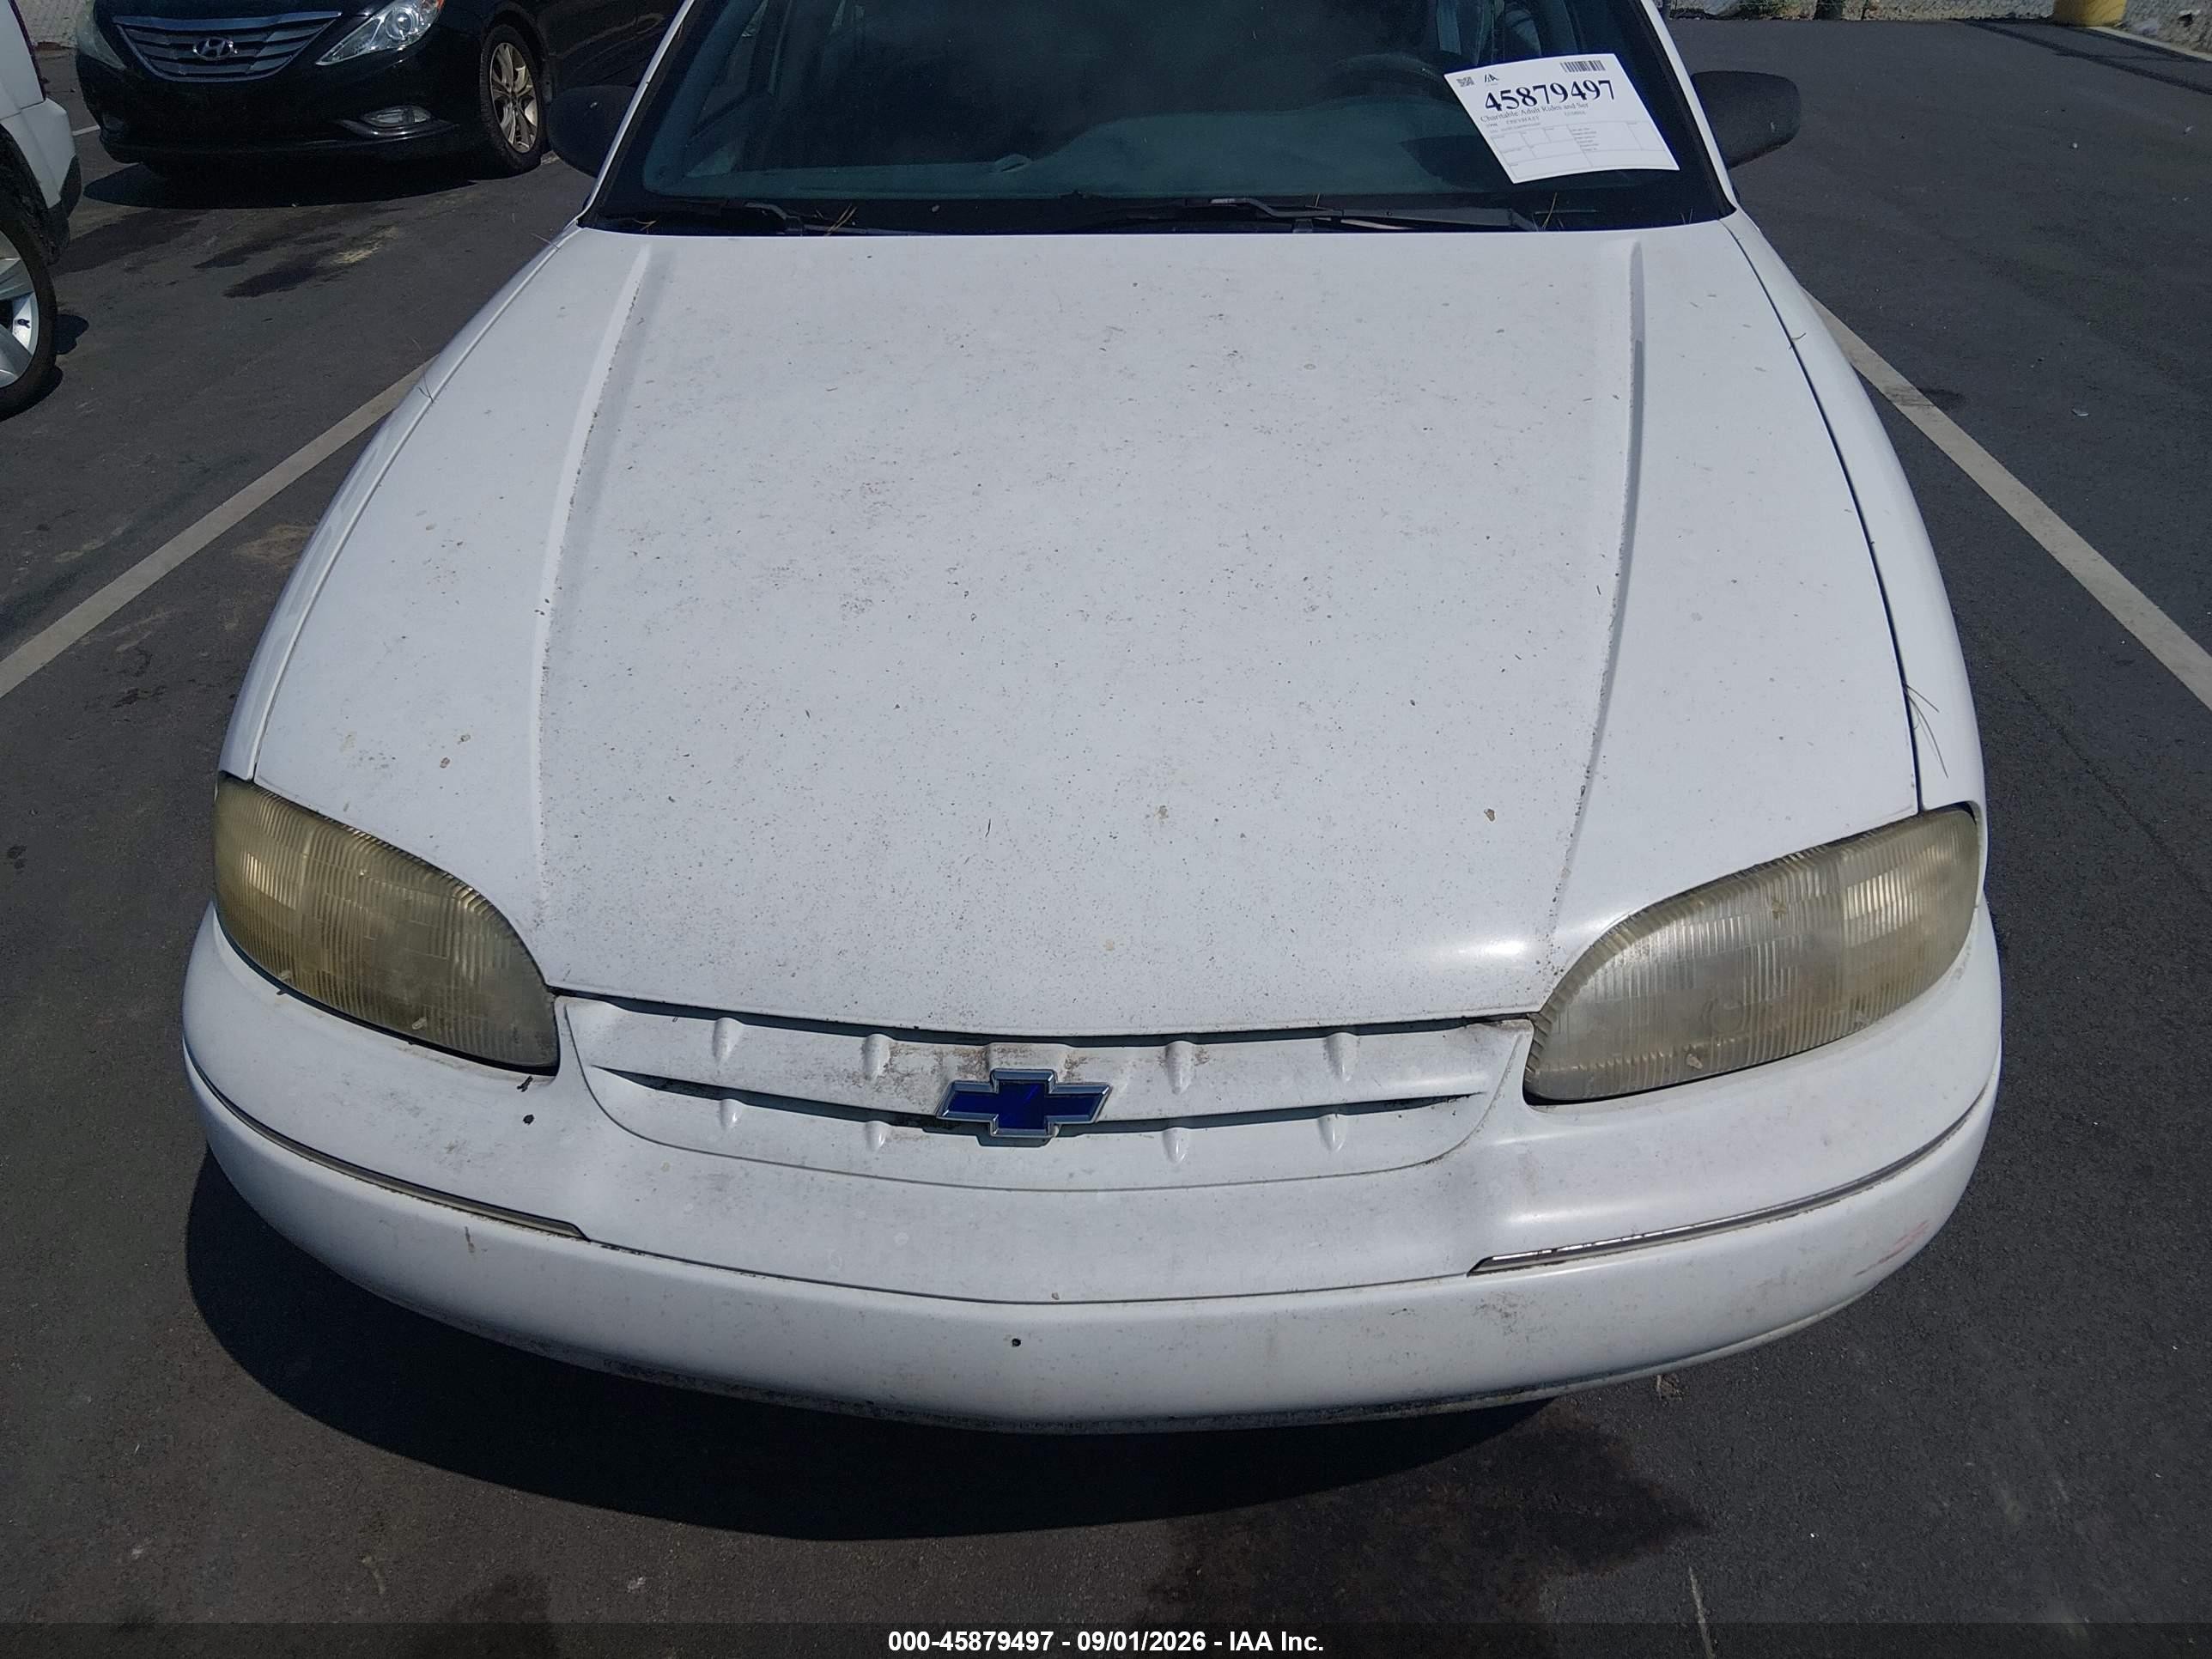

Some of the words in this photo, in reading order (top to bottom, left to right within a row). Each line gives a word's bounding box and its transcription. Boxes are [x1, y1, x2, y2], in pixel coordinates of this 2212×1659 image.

[1486, 80, 1614, 112] 45879497
[1480, 111, 1519, 123] Charitable
[1521, 107, 1540, 116] Adult
